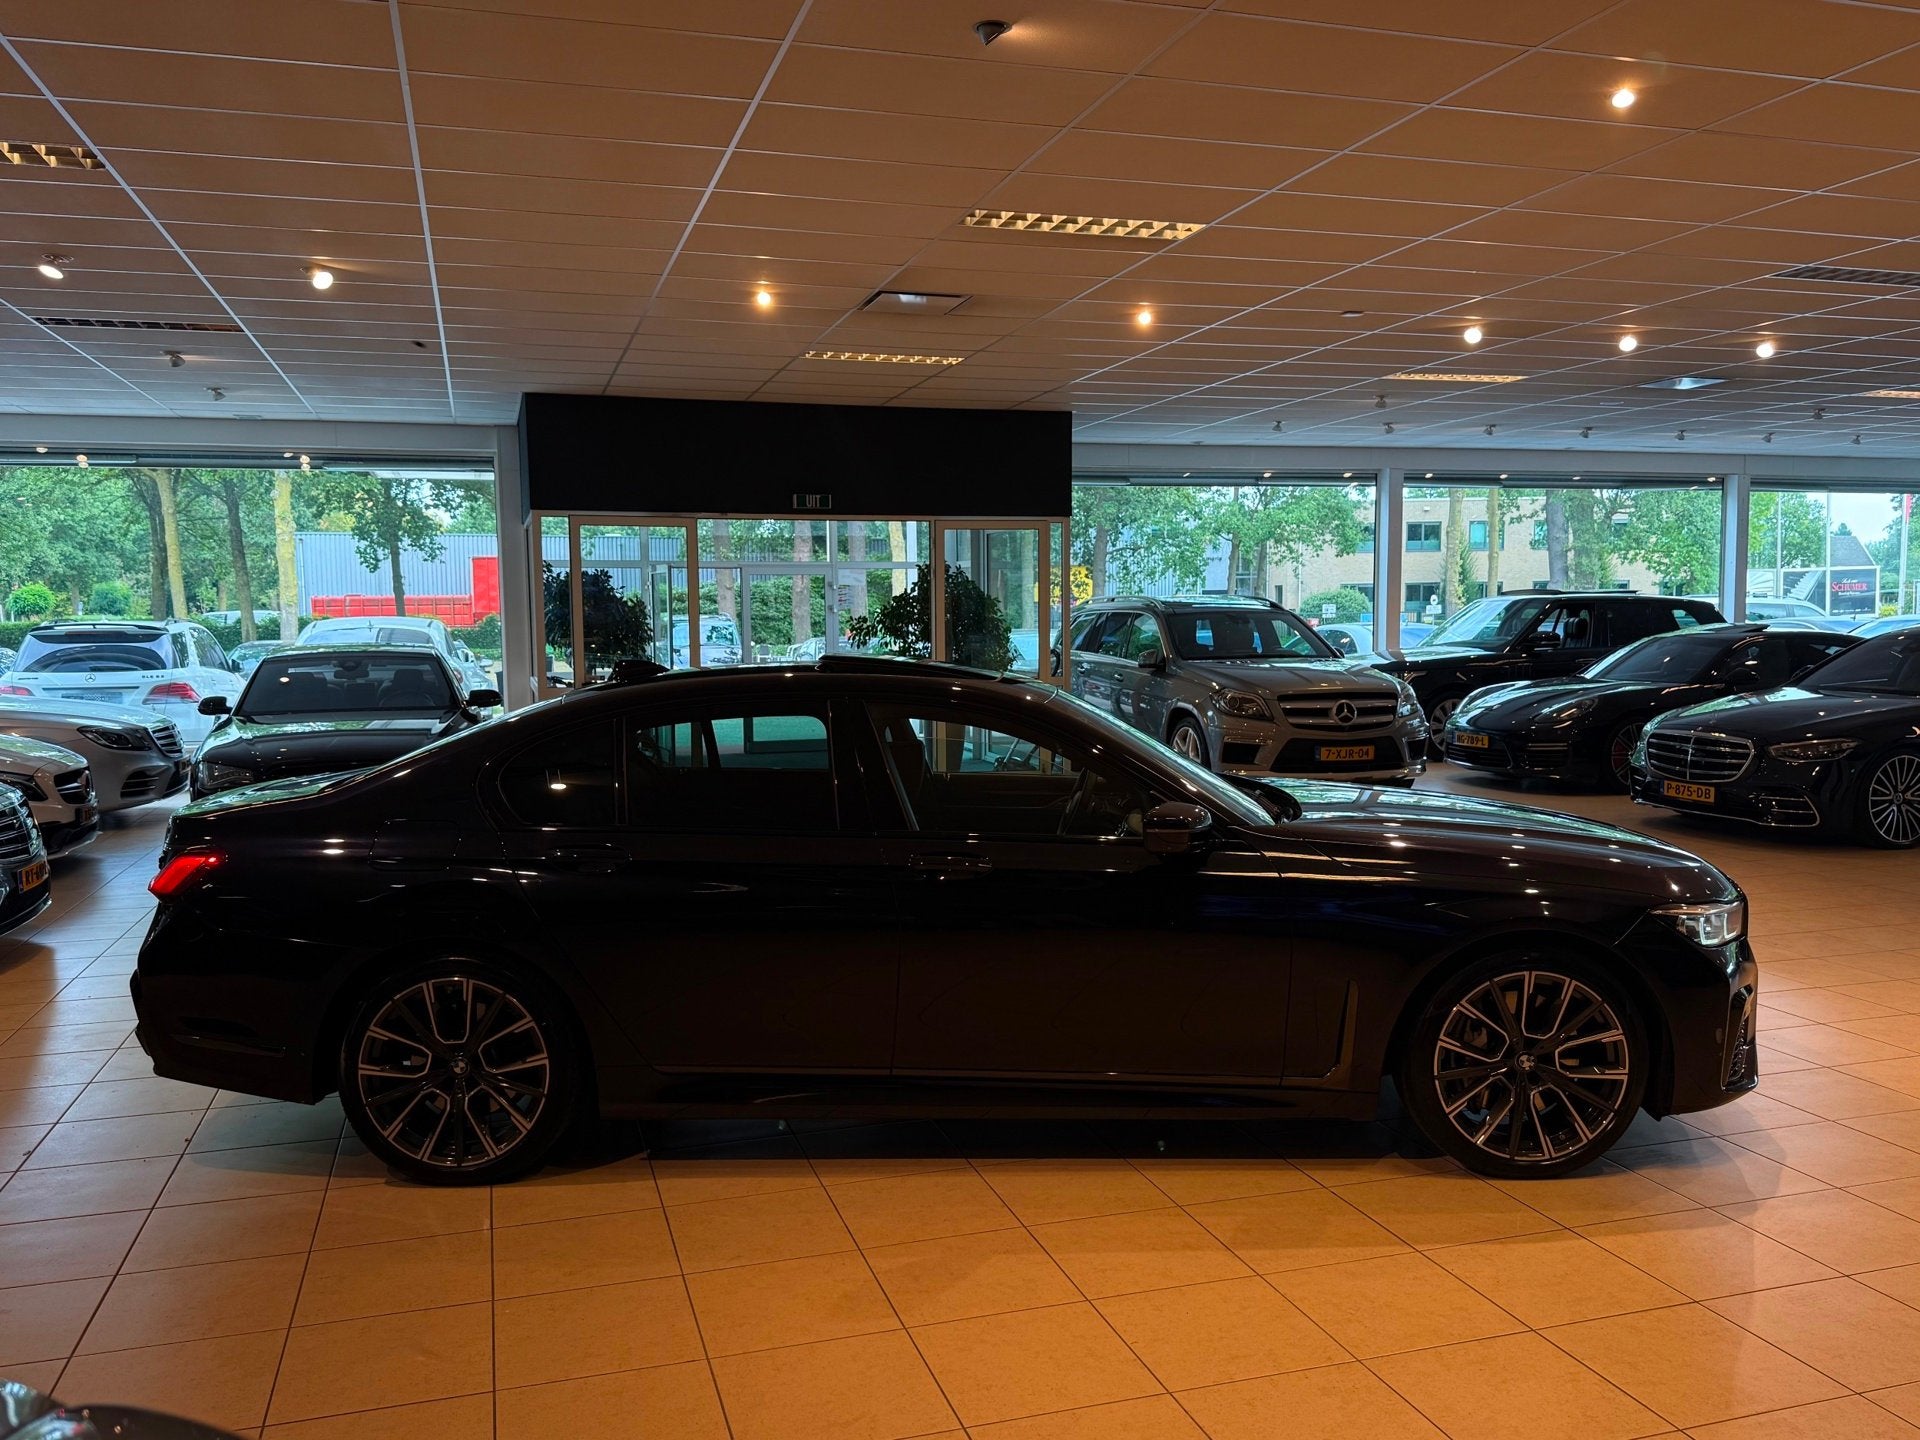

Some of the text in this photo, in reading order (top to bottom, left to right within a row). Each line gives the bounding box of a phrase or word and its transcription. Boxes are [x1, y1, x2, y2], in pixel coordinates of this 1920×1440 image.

[806, 494, 821, 508] UIT
[1325, 747, 1370, 760] 7-XJR-04
[1667, 782, 1711, 800] P-875-DB
